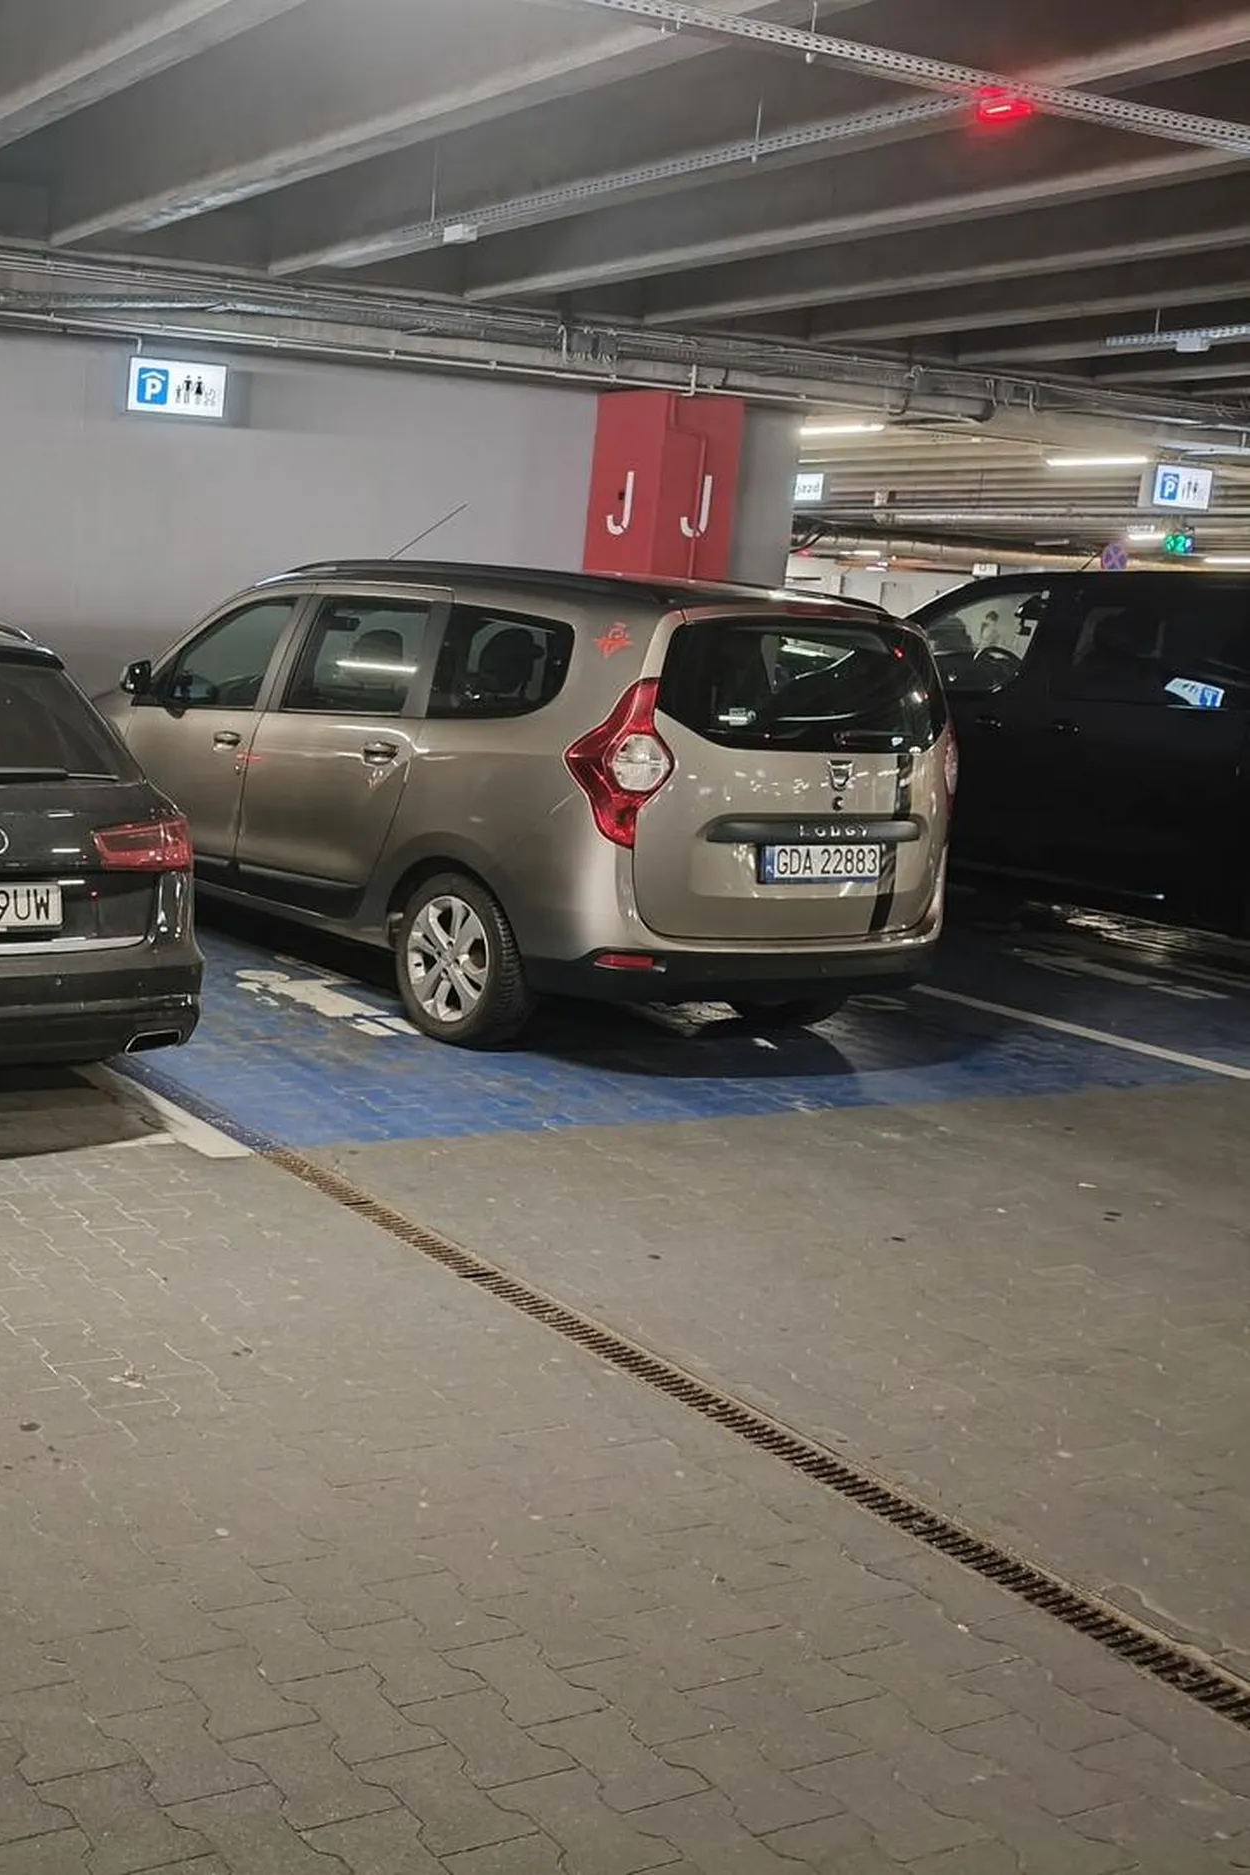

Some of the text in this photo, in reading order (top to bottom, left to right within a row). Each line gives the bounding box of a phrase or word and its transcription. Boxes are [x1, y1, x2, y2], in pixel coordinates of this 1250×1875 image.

[144, 378, 162, 401] P
[606, 471, 635, 535] J
[1163, 481, 1176, 498] P
[680, 475, 713, 538] J
[776, 848, 879, 876] GDA 22883
